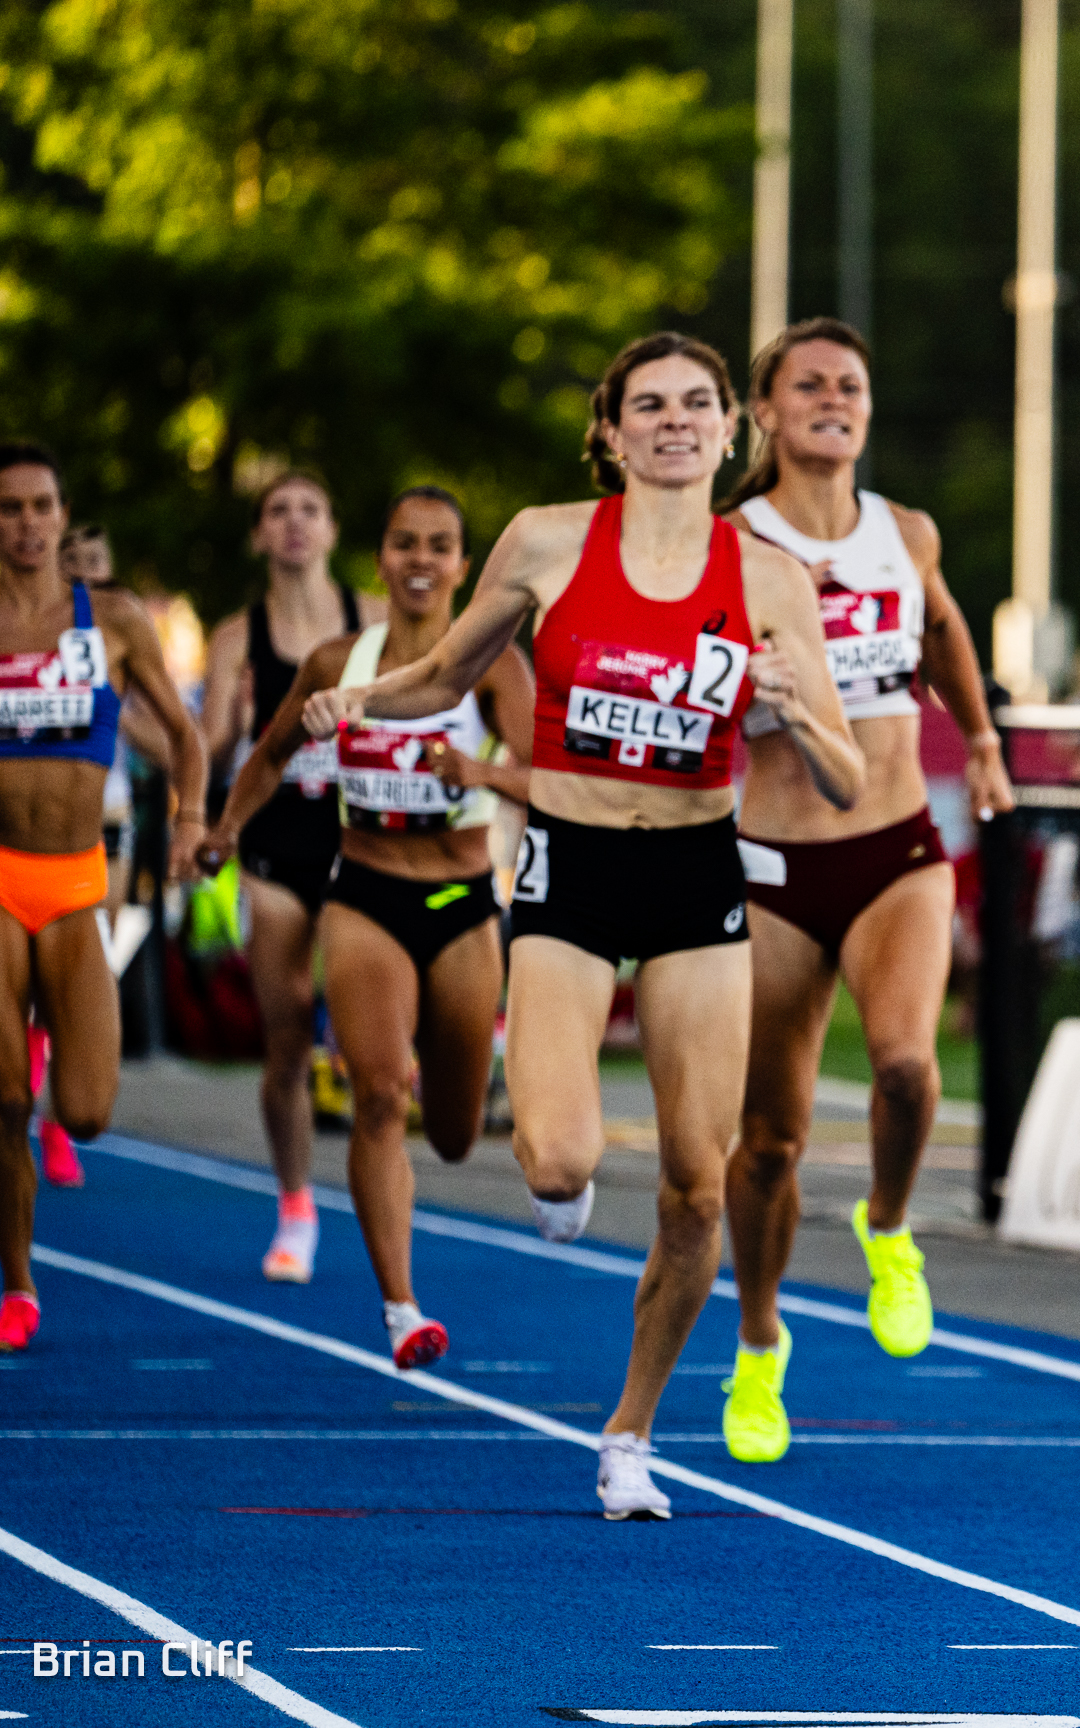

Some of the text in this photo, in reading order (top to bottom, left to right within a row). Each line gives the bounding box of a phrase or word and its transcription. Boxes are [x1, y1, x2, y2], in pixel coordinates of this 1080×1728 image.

[69, 637, 96, 682] 3
[702, 644, 734, 708] 2
[580, 695, 700, 742] KELLY
[515, 833, 536, 895] 2
